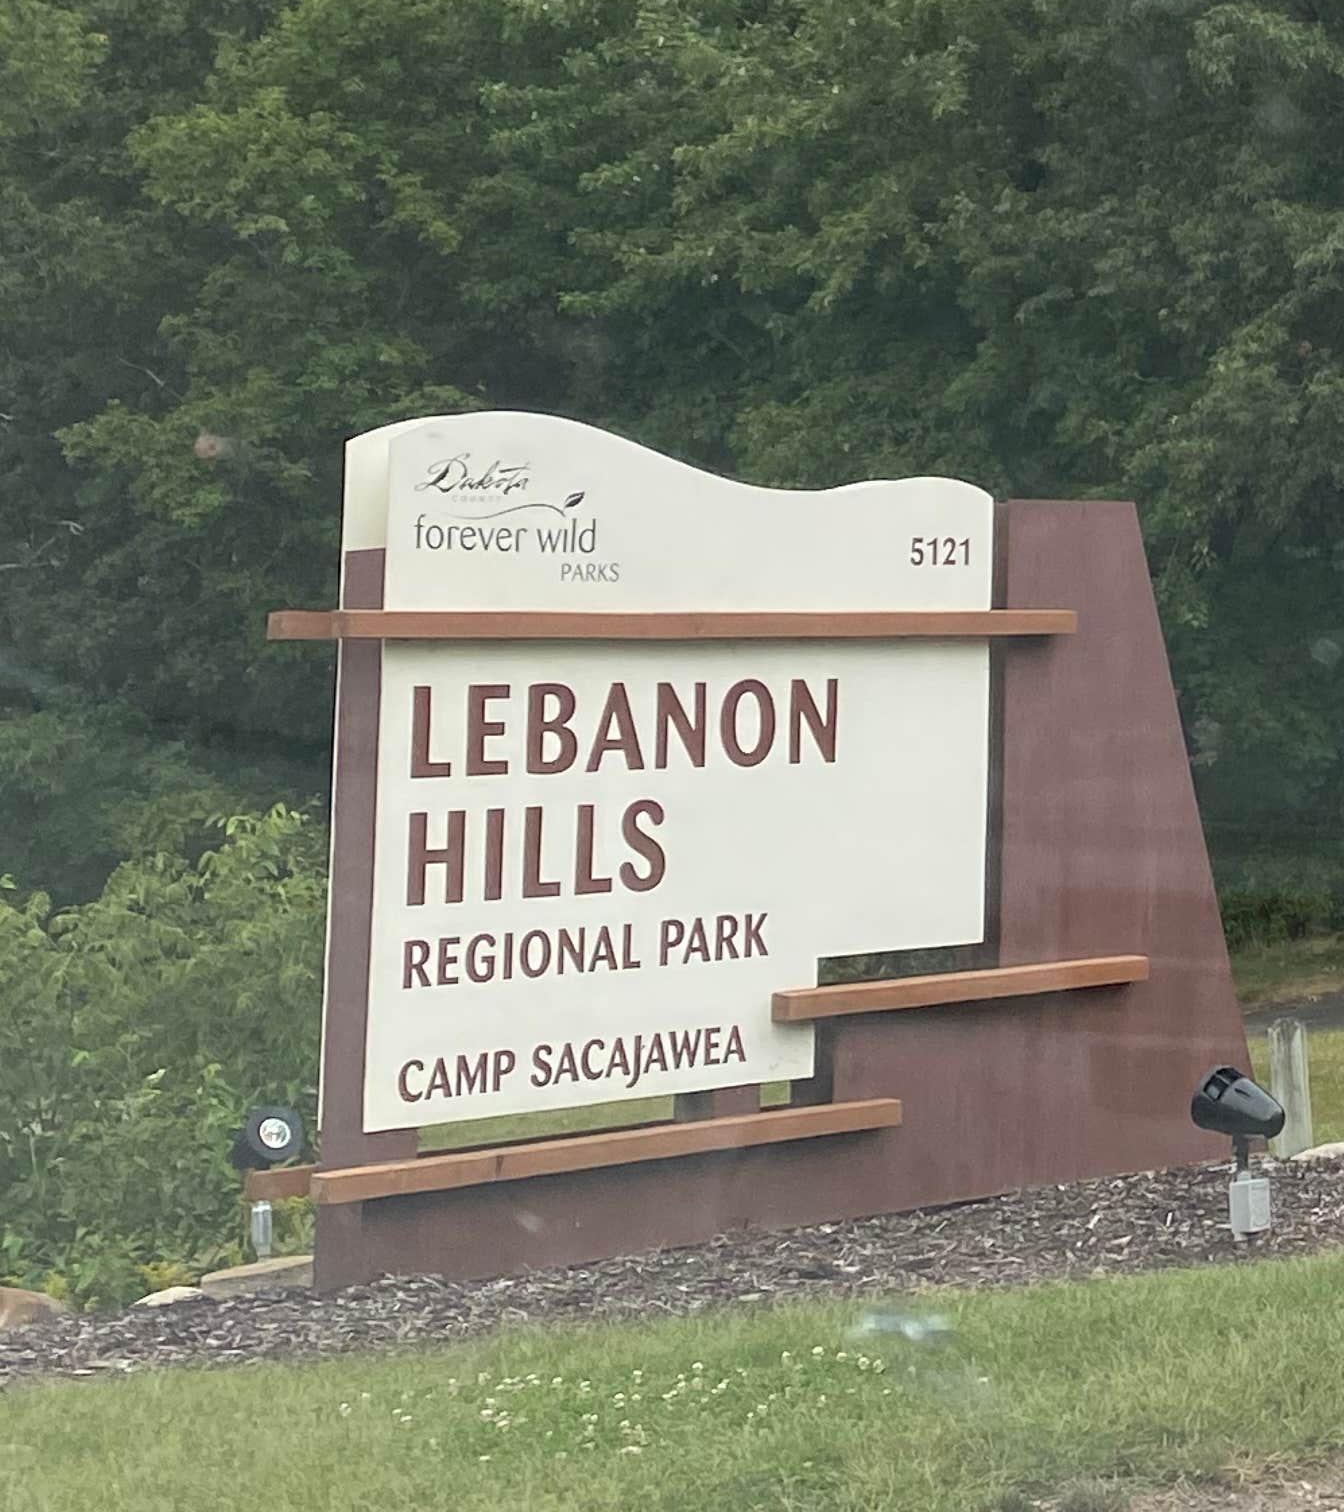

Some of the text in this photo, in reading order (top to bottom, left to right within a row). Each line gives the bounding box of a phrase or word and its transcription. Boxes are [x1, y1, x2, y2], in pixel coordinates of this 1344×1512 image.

[414, 453, 530, 495] Dakota
[414, 514, 597, 554] forever wild
[909, 537, 972, 568] 5121
[560, 562, 620, 582] PARKS
[408, 677, 840, 779] LEBANON
[405, 798, 667, 908] HILLS
[402, 912, 769, 989] REGIONAL PARK
[398, 1024, 747, 1103] CAMP SACAJAWEA
